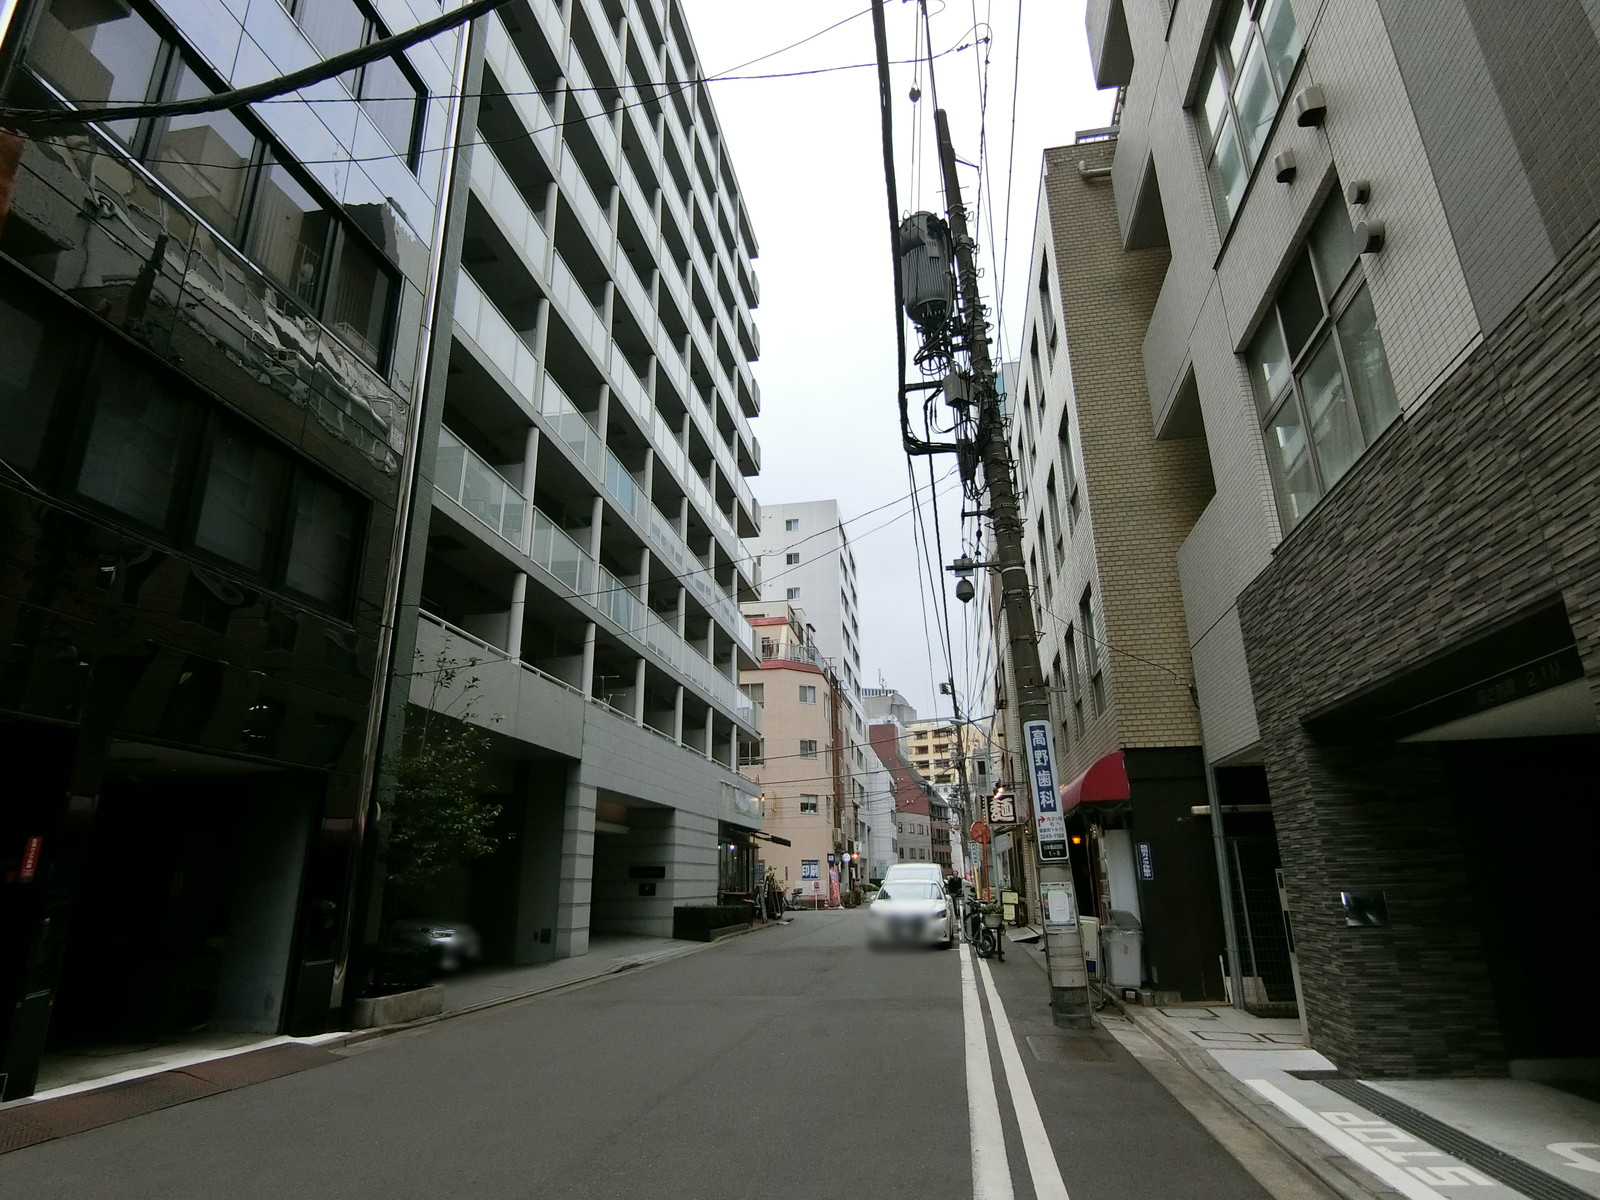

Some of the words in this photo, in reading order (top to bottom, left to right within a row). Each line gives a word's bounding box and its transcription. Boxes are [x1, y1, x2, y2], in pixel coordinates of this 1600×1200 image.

[1031, 729, 1055, 808] 高野歯科
[990, 797, 1015, 822] 麺
[1318, 1111, 1496, 1186] STOP
